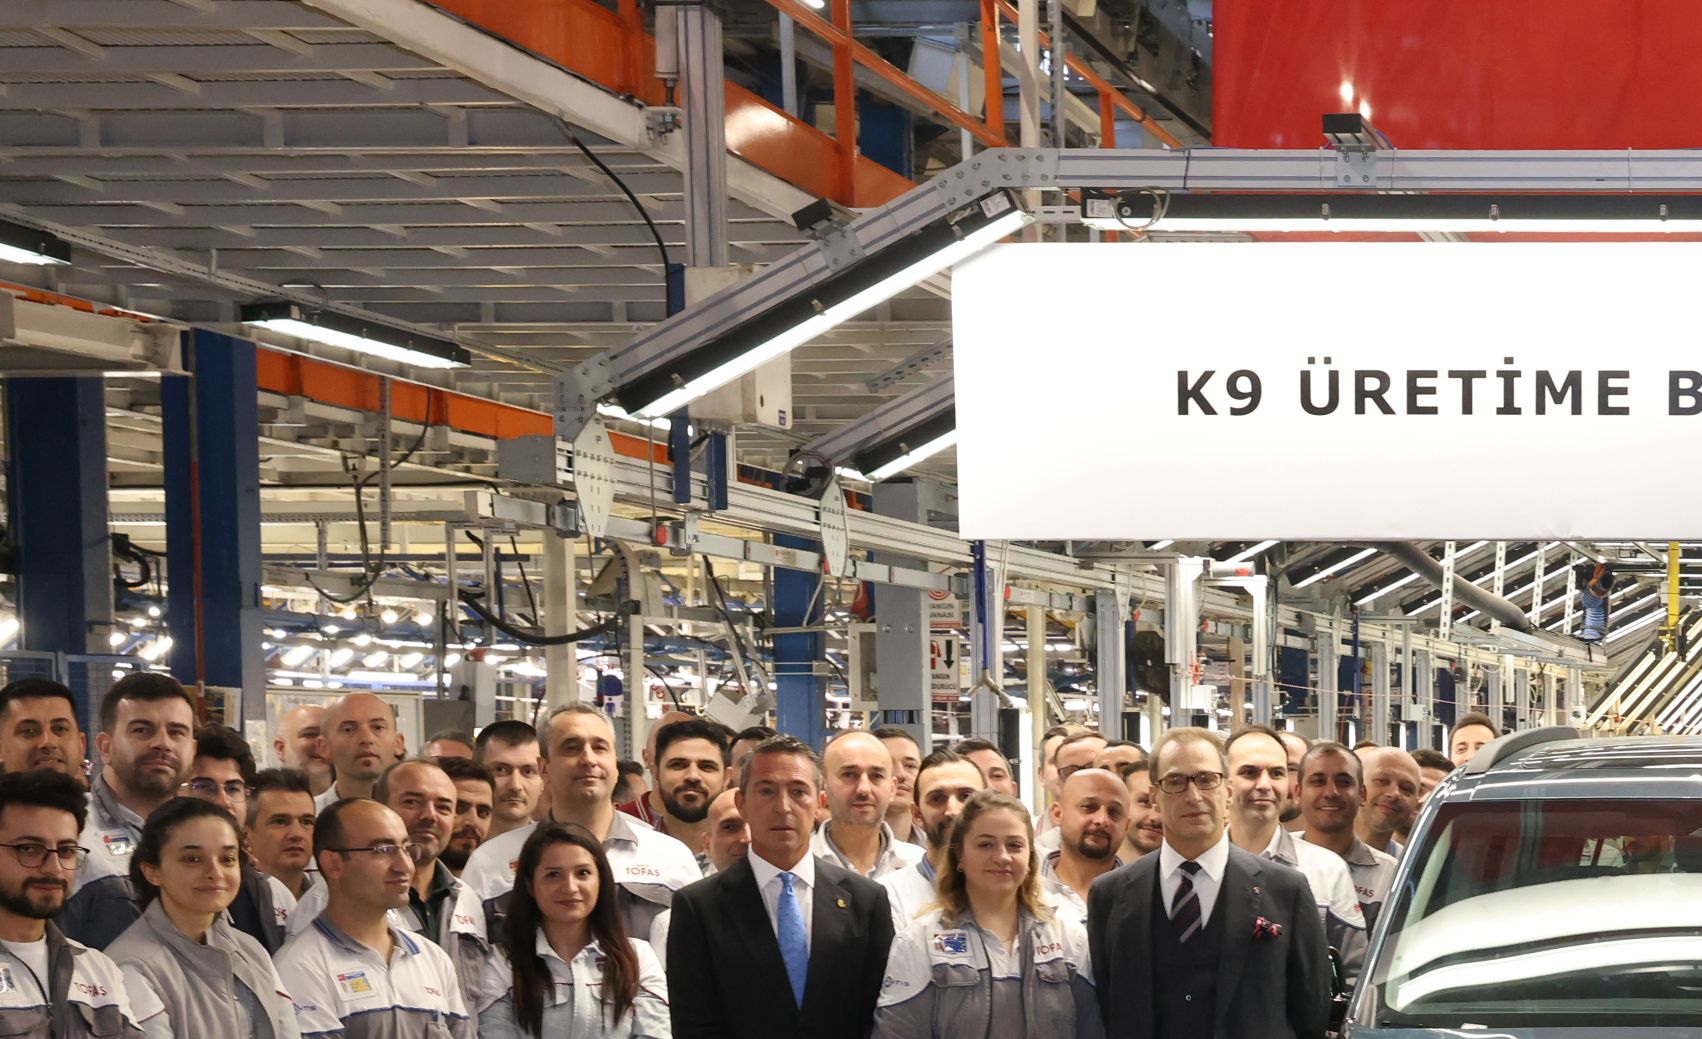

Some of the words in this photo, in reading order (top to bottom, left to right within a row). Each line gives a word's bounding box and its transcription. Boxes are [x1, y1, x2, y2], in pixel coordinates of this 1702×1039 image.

[1177, 368, 1262, 417] K9
[1299, 356, 1631, 417] ÜRETİME
[1035, 943, 1062, 956] TOFA
